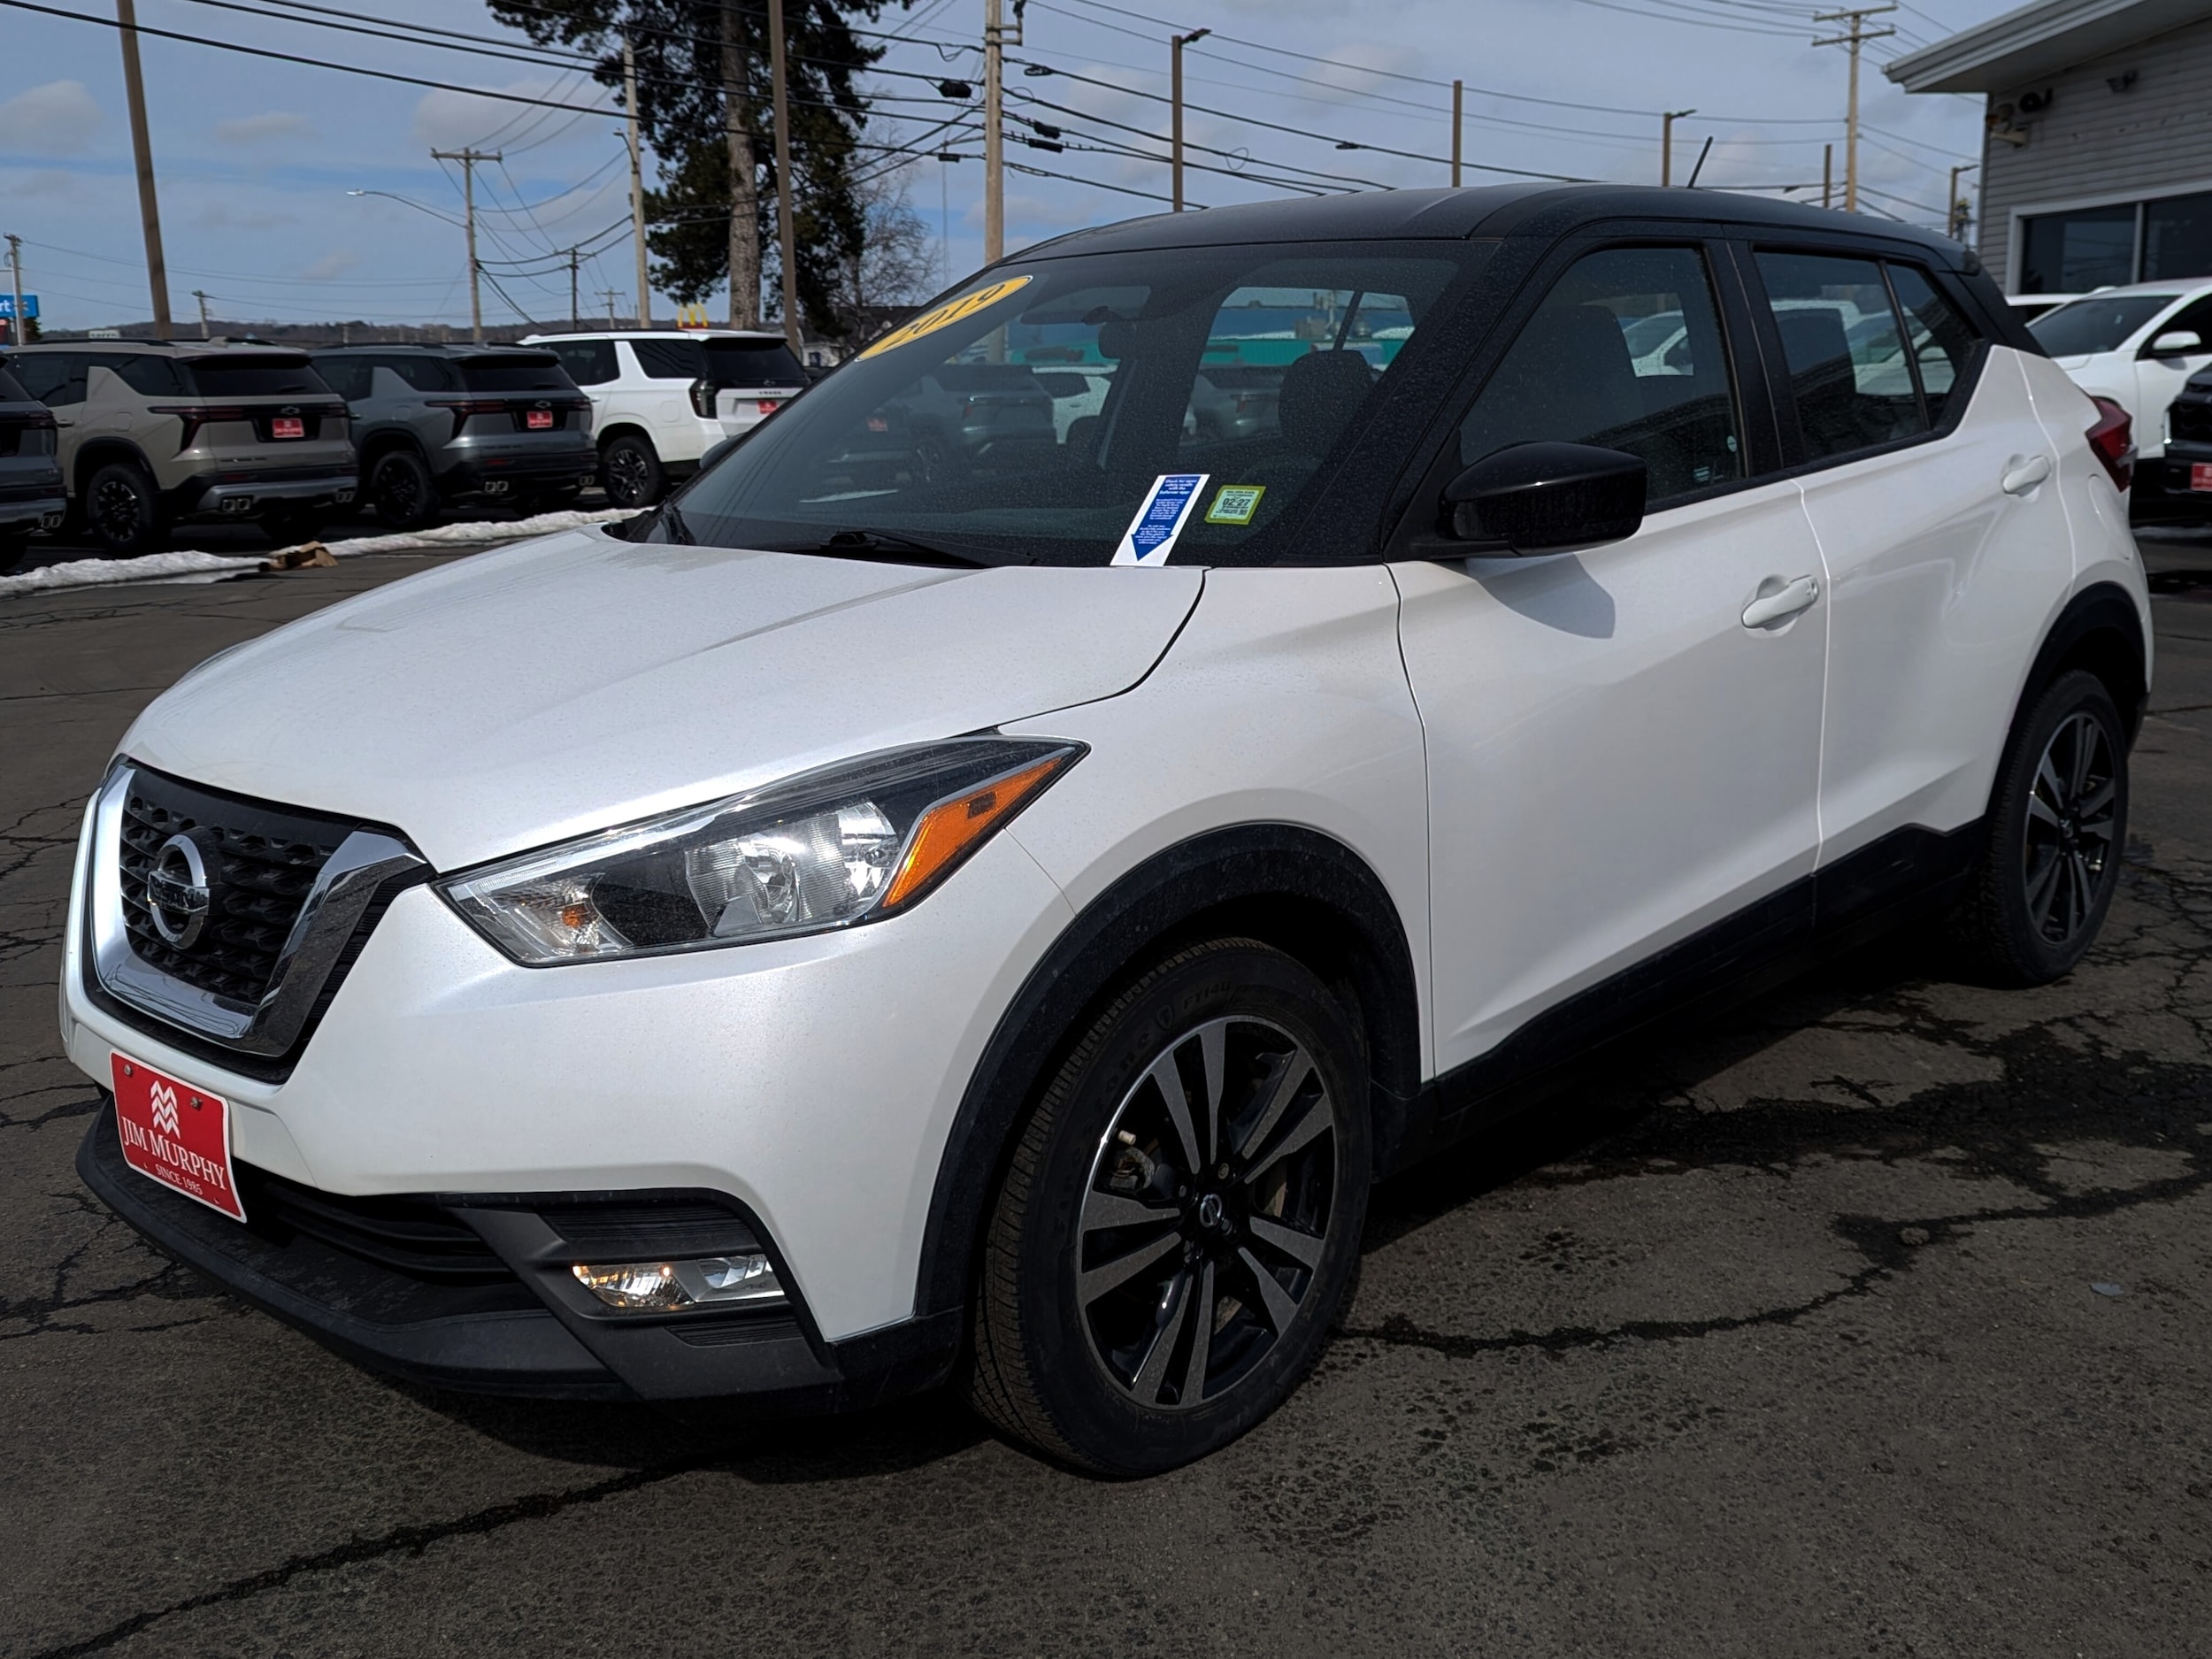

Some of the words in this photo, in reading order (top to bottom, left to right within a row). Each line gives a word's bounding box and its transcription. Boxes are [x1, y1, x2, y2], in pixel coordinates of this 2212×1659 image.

[881, 283, 1006, 350] 2019
[121, 1117, 150, 1152] JIM
[148, 1129, 227, 1190] MURPHY
[155, 1164, 181, 1186] SINCE
[182, 1177, 204, 1195] 1985
